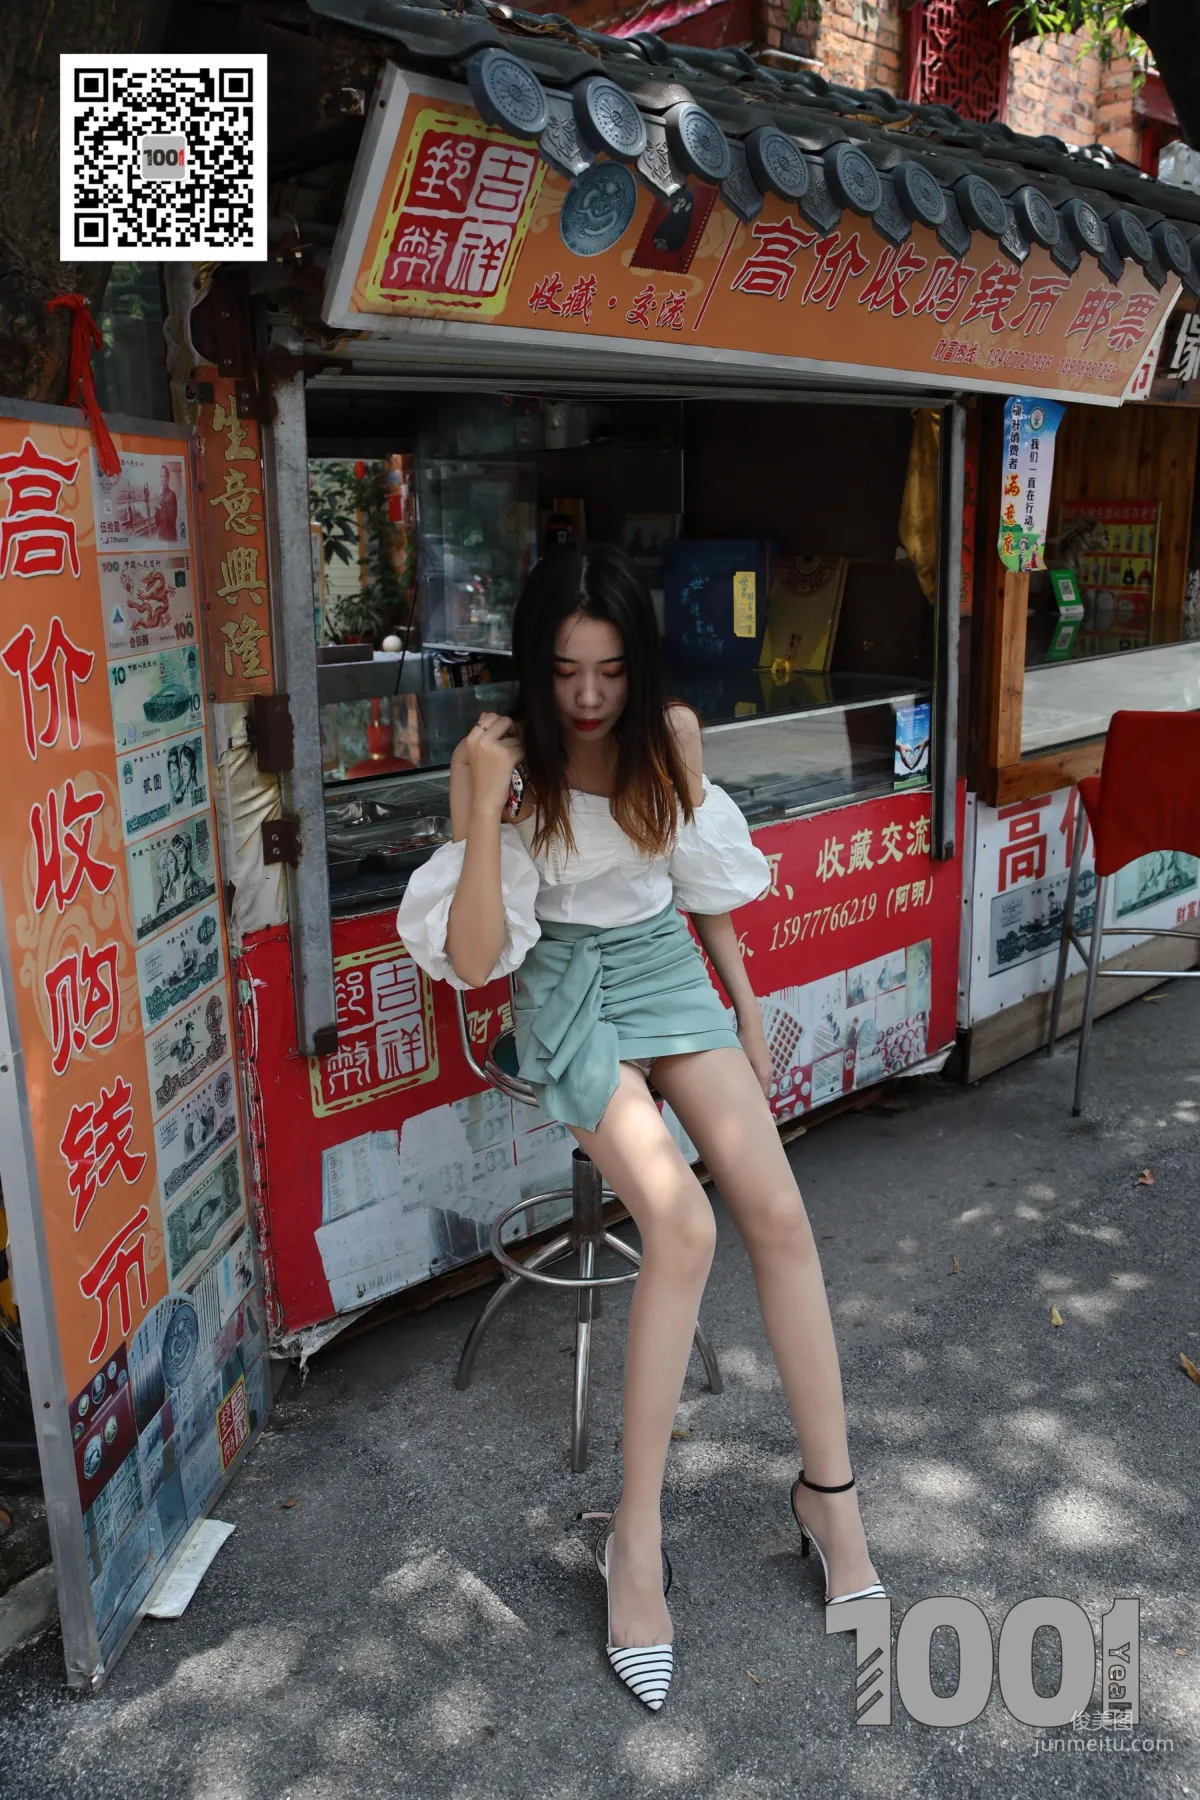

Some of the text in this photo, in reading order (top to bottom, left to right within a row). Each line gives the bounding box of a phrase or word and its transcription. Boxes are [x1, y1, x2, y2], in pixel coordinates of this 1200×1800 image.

[729, 216, 1161, 353] 高价收购钱币 邮票
[1024, 438, 1040, 527] 我们一直在行动
[112, 666, 127, 686] 10
[815, 814, 932, 884] 收藏交流
[0, 436, 149, 1365] 高价收购钱币
[768, 892, 878, 953] 15977766219
